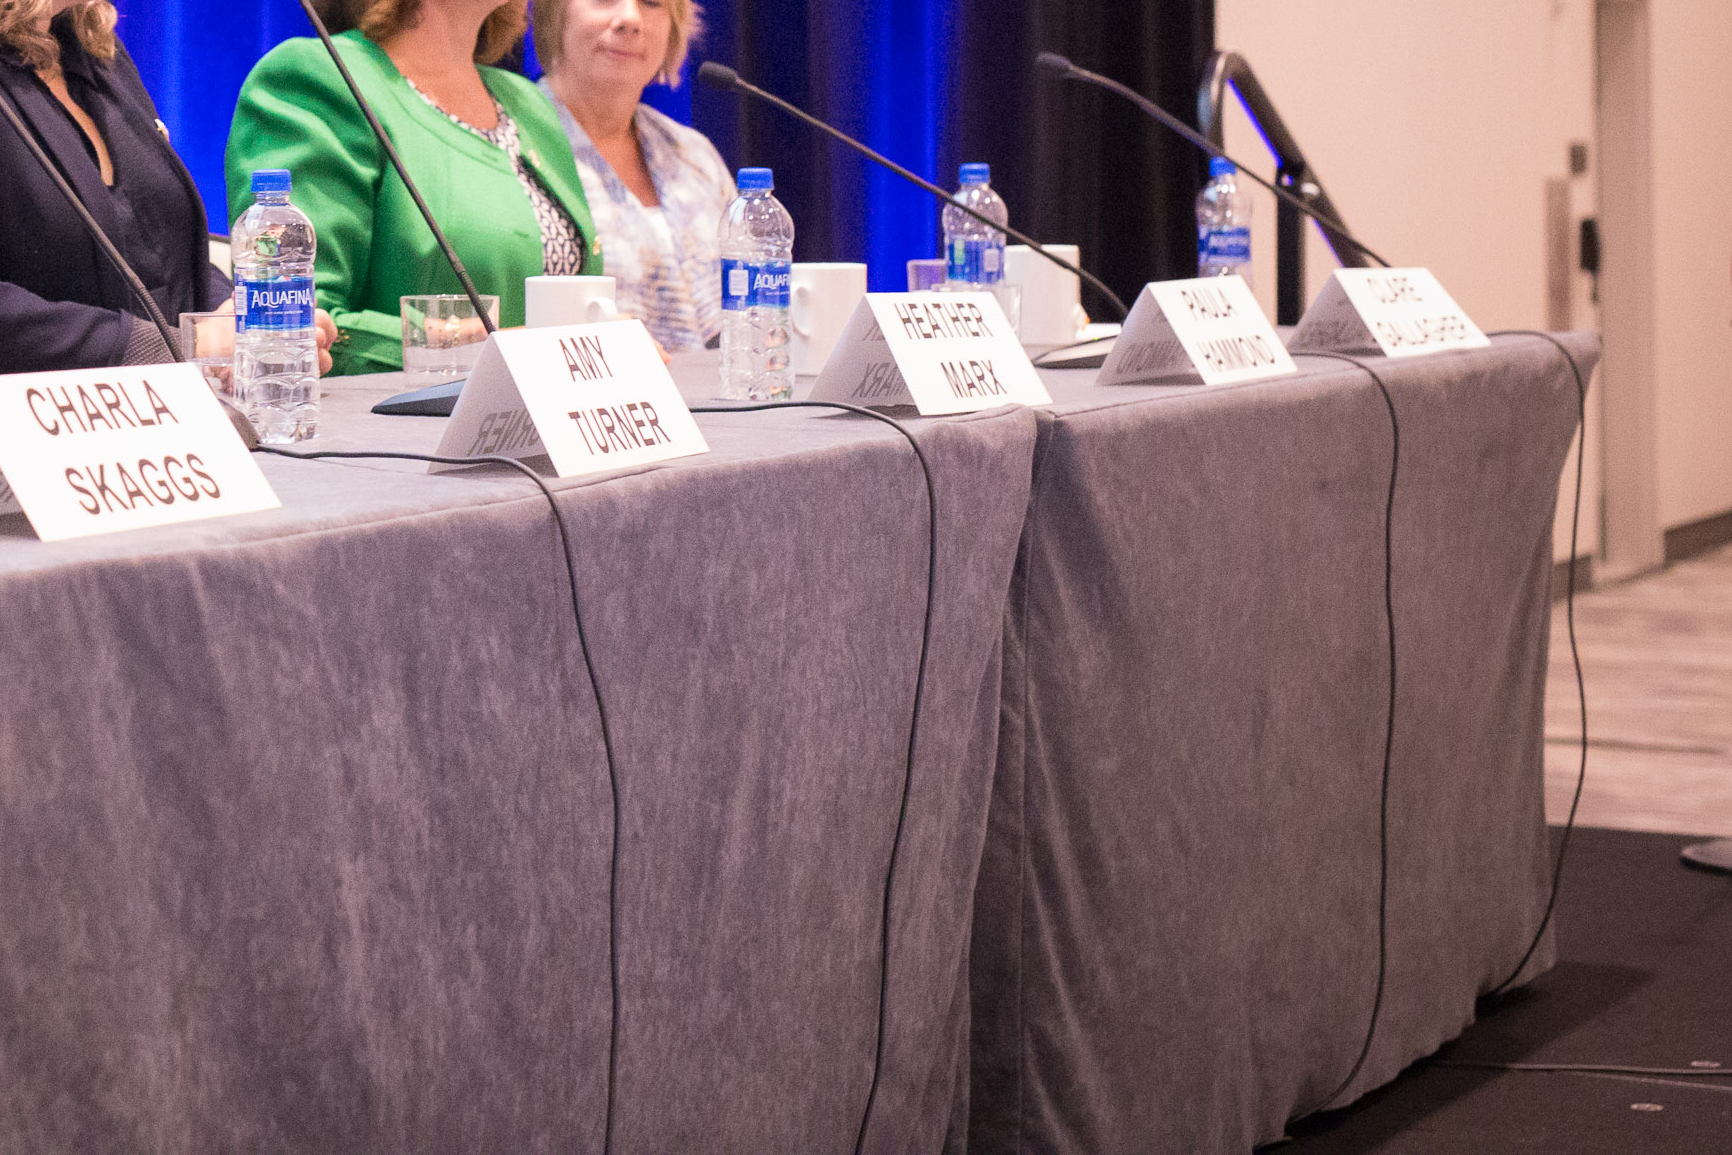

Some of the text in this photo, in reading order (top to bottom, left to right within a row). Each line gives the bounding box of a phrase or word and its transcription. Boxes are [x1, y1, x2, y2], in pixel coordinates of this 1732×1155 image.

[251, 288, 313, 308] AQUAFINA
[1180, 287, 1238, 321] PAULA
[895, 303, 993, 340] HEATHER
[559, 335, 613, 382] AMY
[940, 360, 1007, 399] MARX
[26, 379, 179, 436] CHARLA
[568, 402, 671, 455] TURNER
[65, 453, 221, 515] SKAGGS
